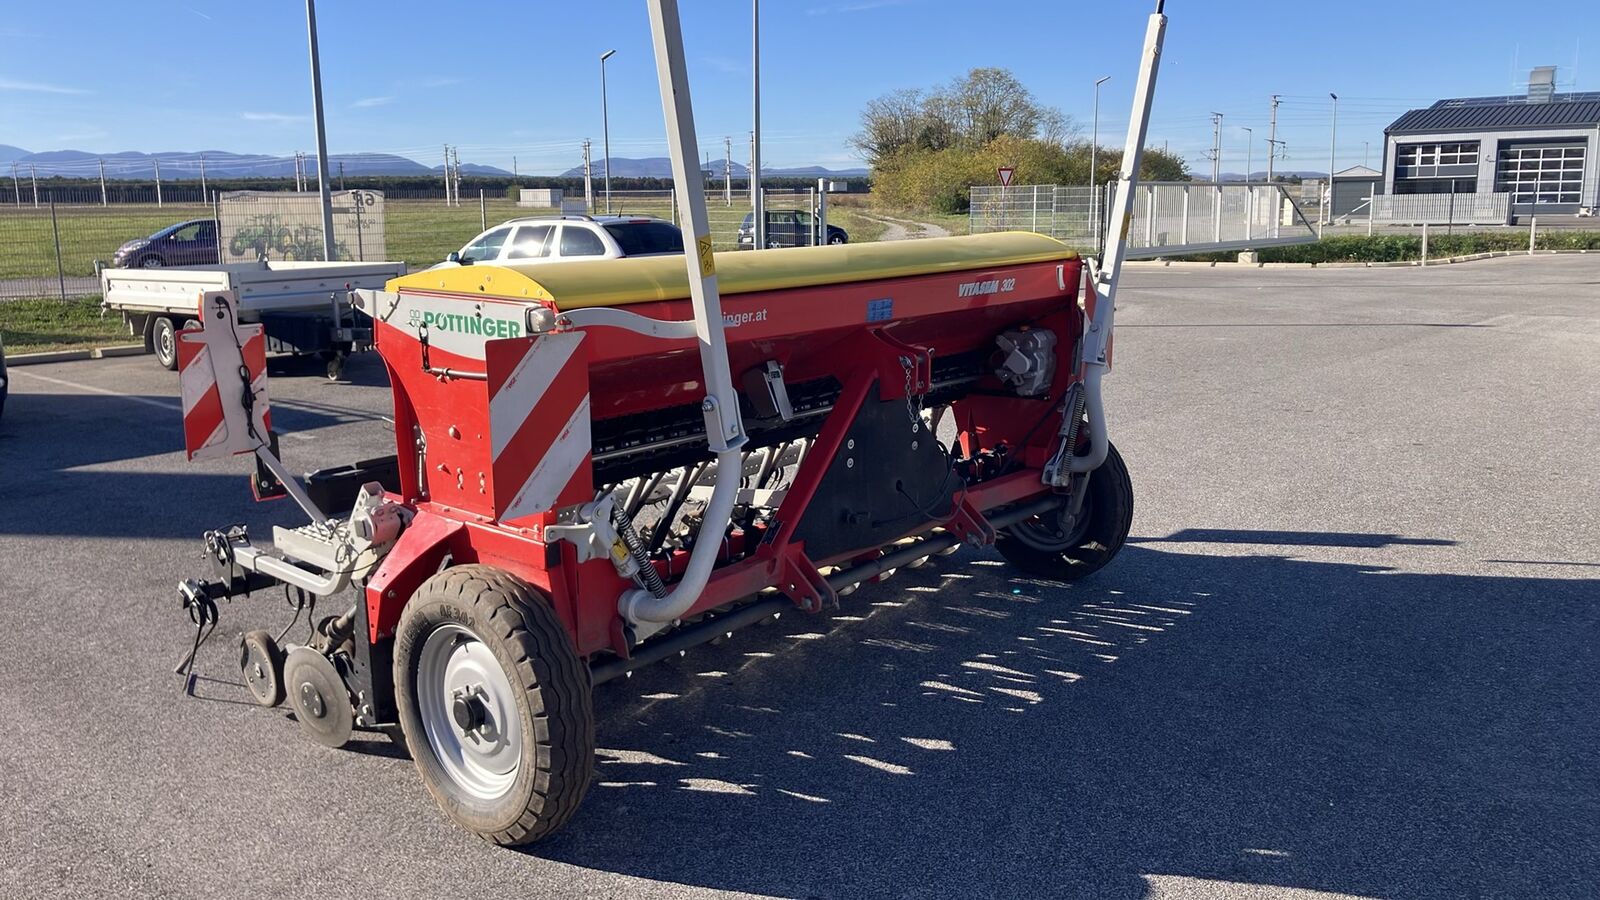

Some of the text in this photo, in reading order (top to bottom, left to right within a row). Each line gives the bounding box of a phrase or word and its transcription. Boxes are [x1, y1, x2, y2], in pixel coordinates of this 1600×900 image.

[959, 278, 1015, 297] VITASEM 302
[722, 309, 768, 327] inger.at
